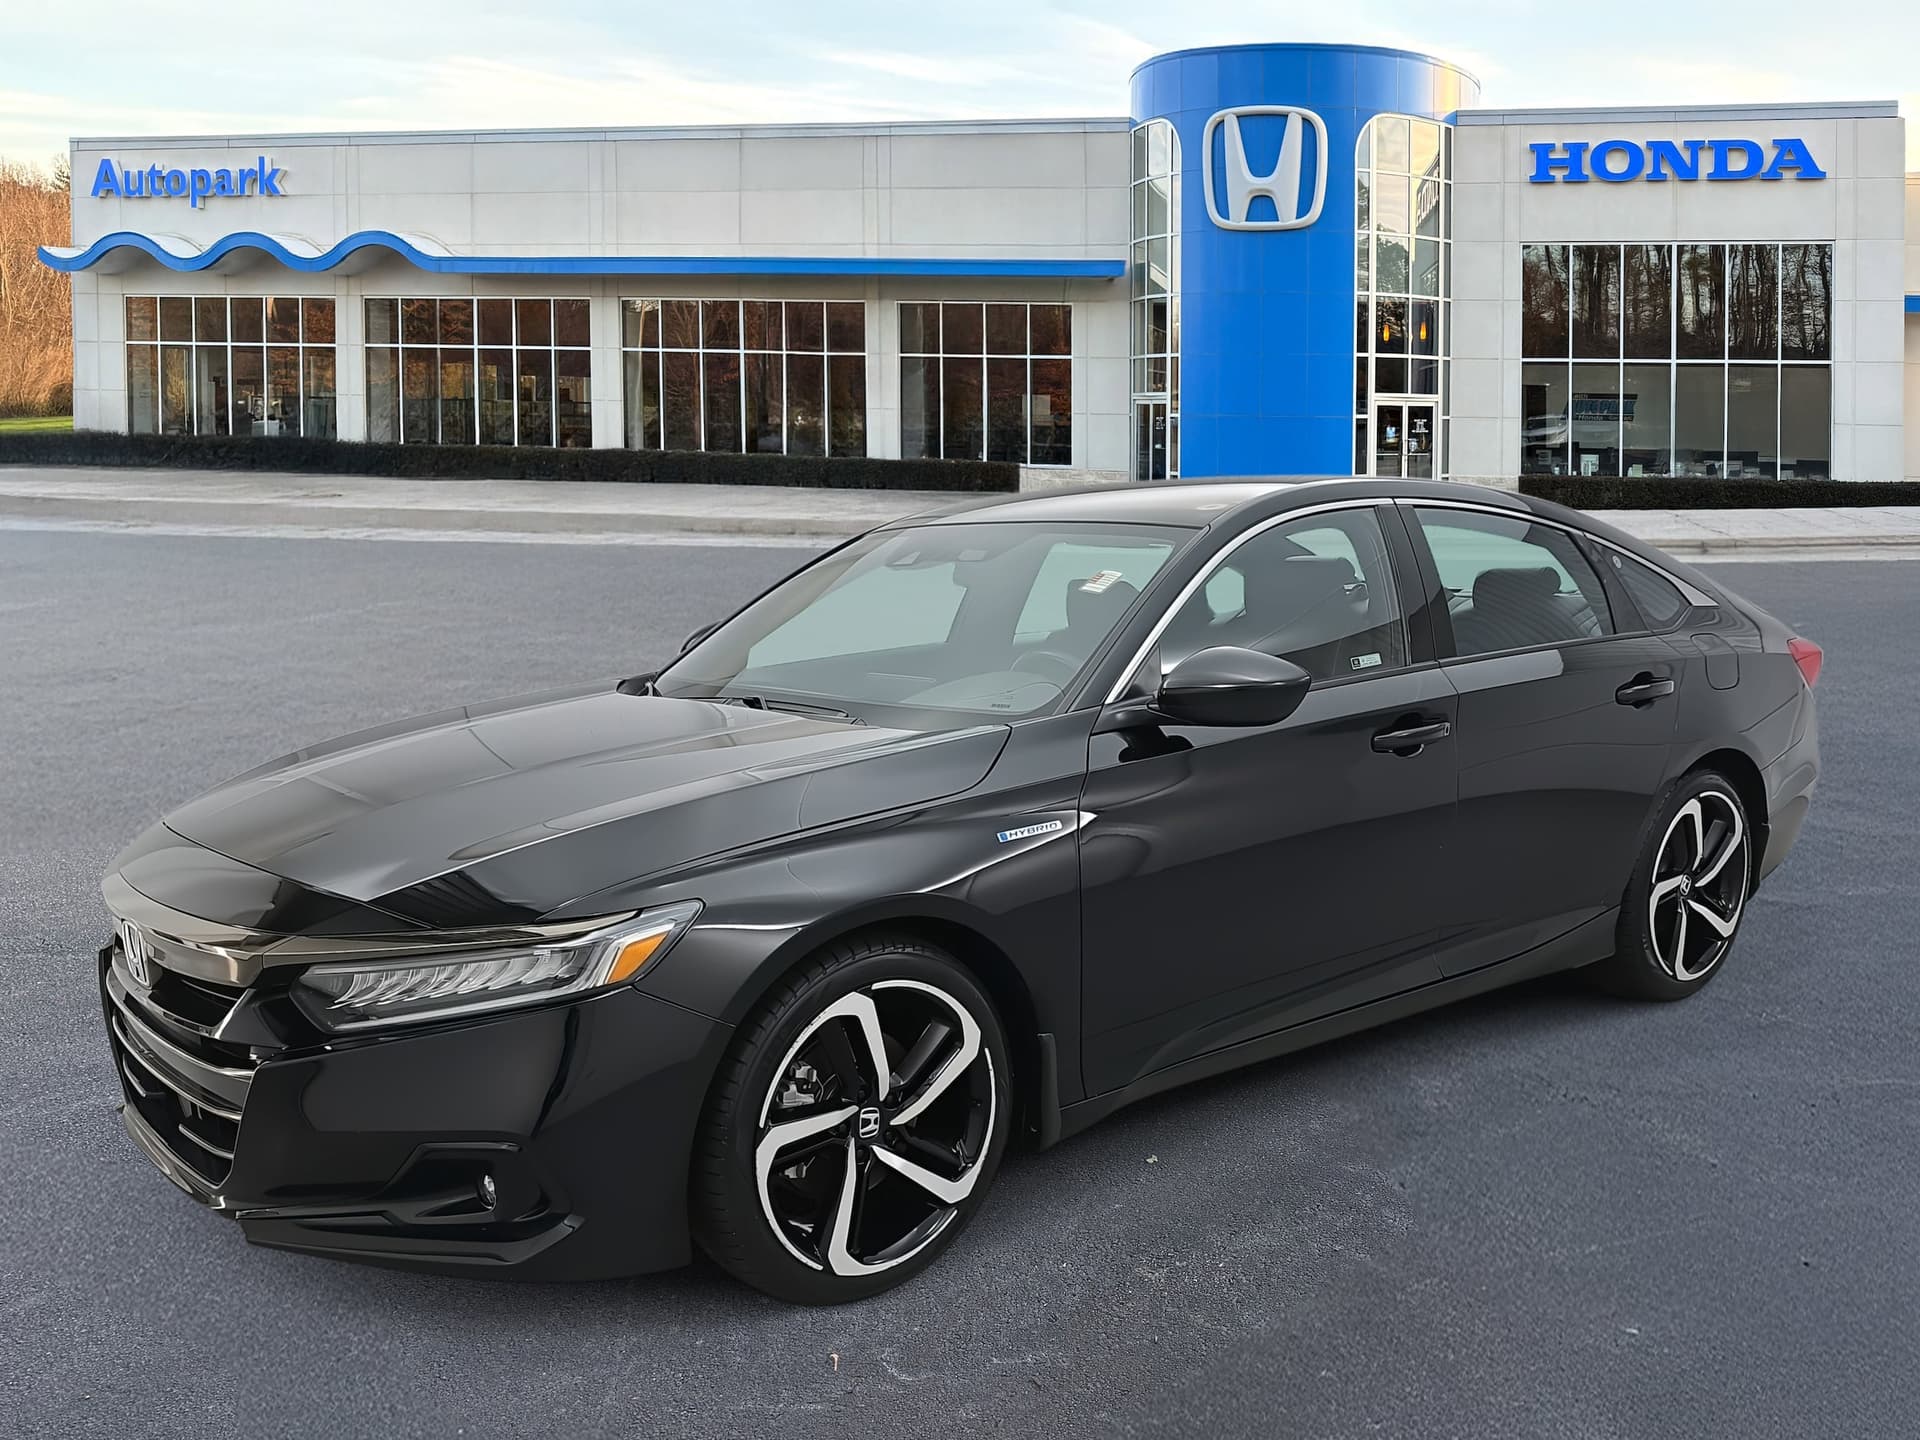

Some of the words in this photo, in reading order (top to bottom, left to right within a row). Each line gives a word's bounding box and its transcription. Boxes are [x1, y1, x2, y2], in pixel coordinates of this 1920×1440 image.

[91, 155, 282, 209] Autopark
[1529, 138, 1827, 183] HONDA
[1009, 822, 1058, 838] HYBRID
